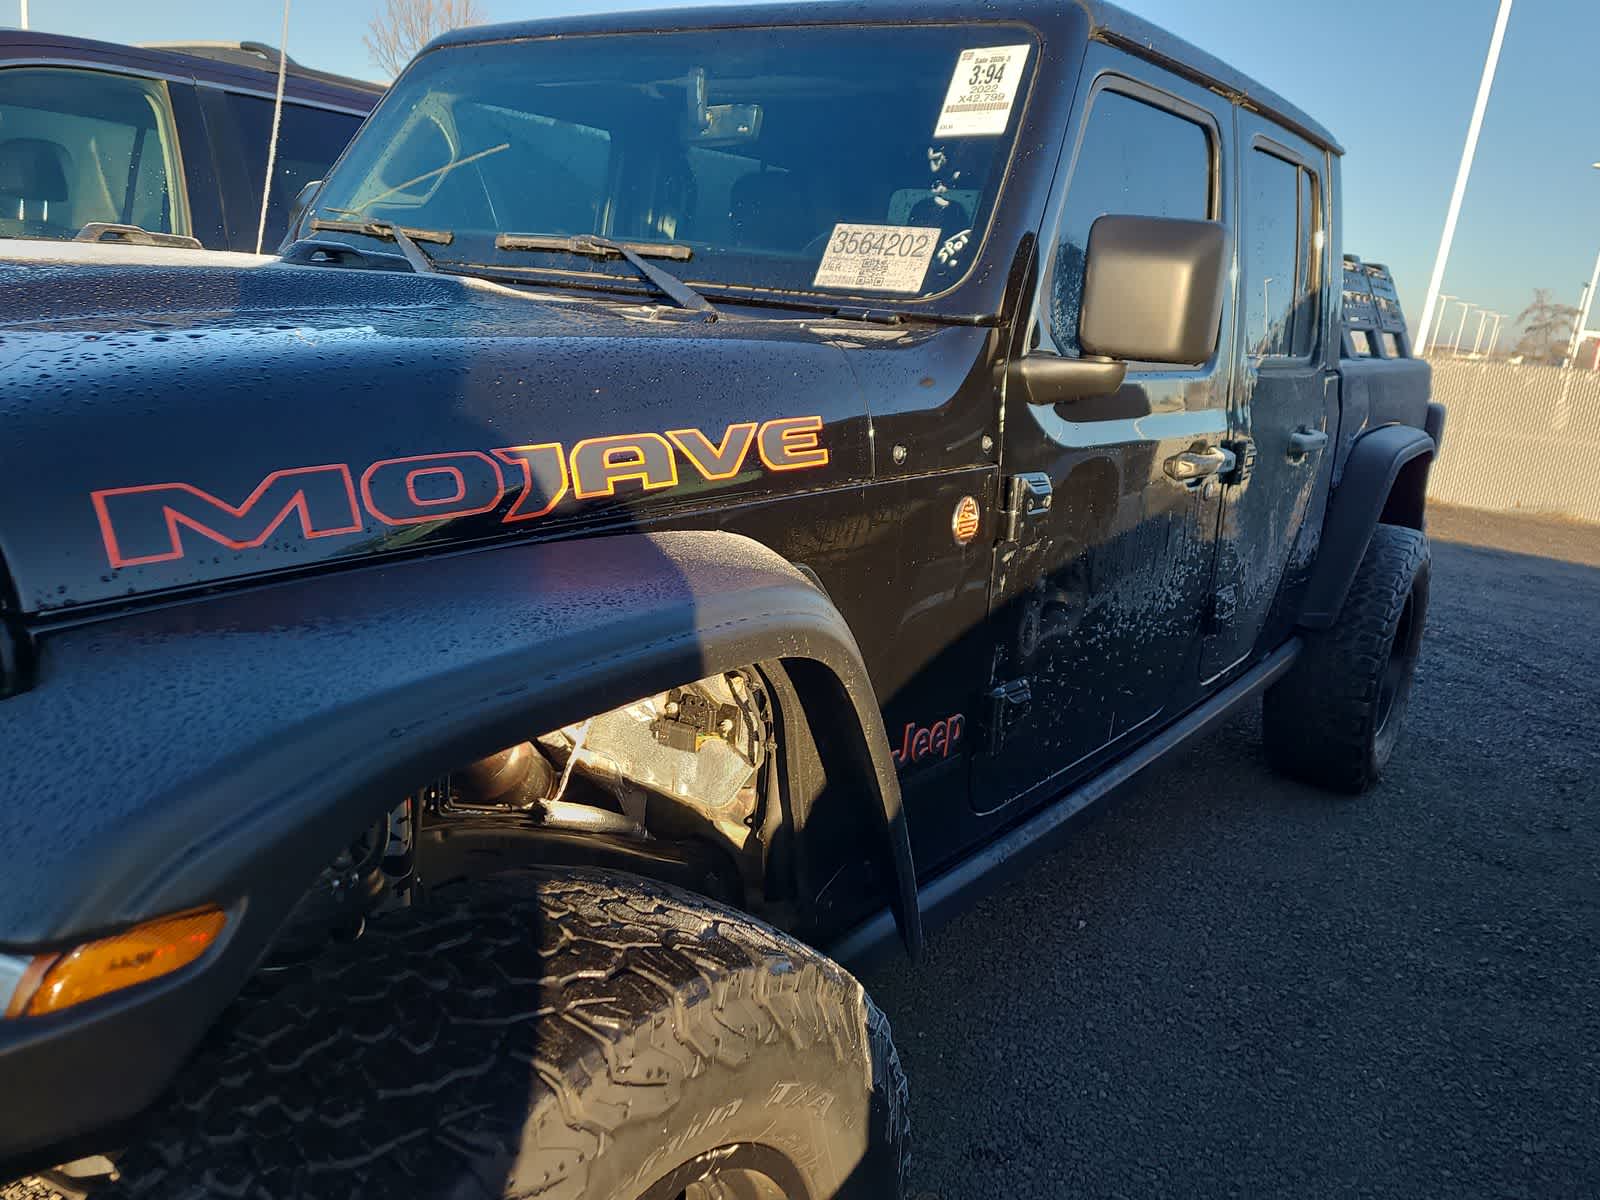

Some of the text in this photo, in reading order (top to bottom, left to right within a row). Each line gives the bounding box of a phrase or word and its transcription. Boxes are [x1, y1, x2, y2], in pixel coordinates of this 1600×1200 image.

[968, 63, 1007, 86] 3:94
[969, 84, 999, 94] 2022
[832, 231, 929, 258] 3564202
[91, 415, 829, 569] MOJAVE
[891, 713, 966, 763] Jeep
